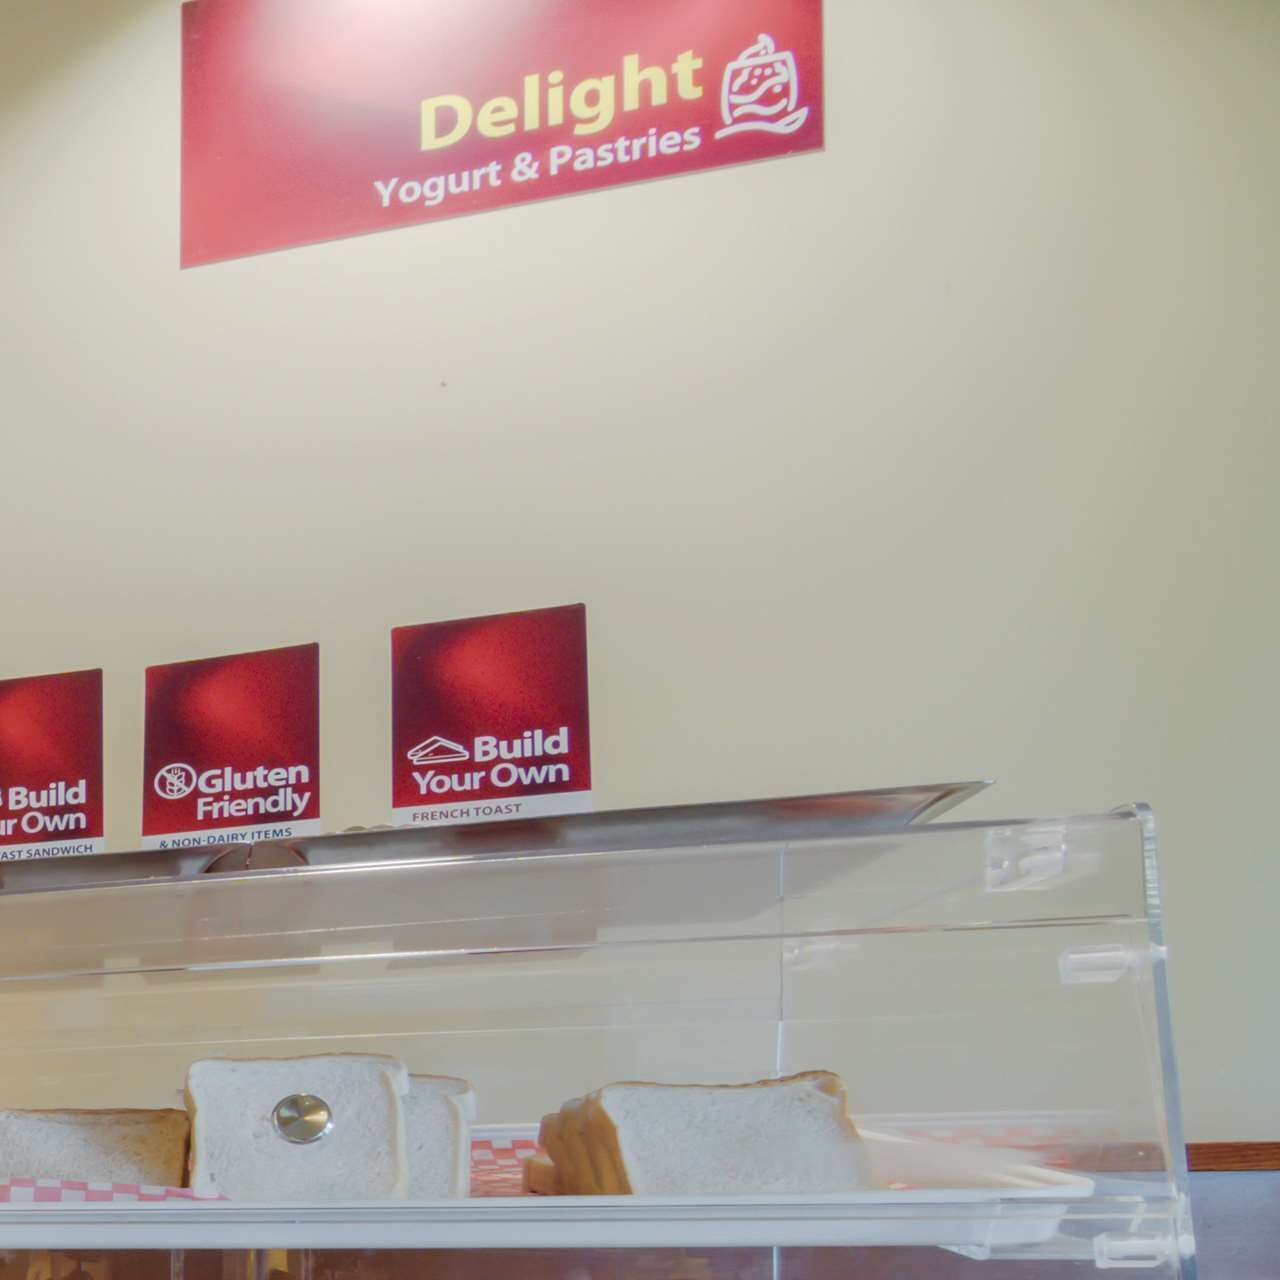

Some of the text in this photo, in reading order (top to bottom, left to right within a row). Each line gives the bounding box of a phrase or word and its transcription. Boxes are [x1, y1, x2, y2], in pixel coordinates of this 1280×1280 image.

[420, 49, 704, 151] Delight
[374, 125, 702, 208] Yogurt & Pastries
[474, 726, 569, 762] Build
[197, 764, 309, 794] Gluten
[412, 762, 570, 795] Your Own
[8, 779, 86, 811] Build
[197, 787, 311, 820] Friendly
[21, 811, 86, 833] Own
[412, 803, 523, 822] FRENCH TOAST
[27, 844, 93, 858] SANDWICH
[172, 832, 248, 848] NON-DAIRY
[251, 827, 292, 841] ITEMS
